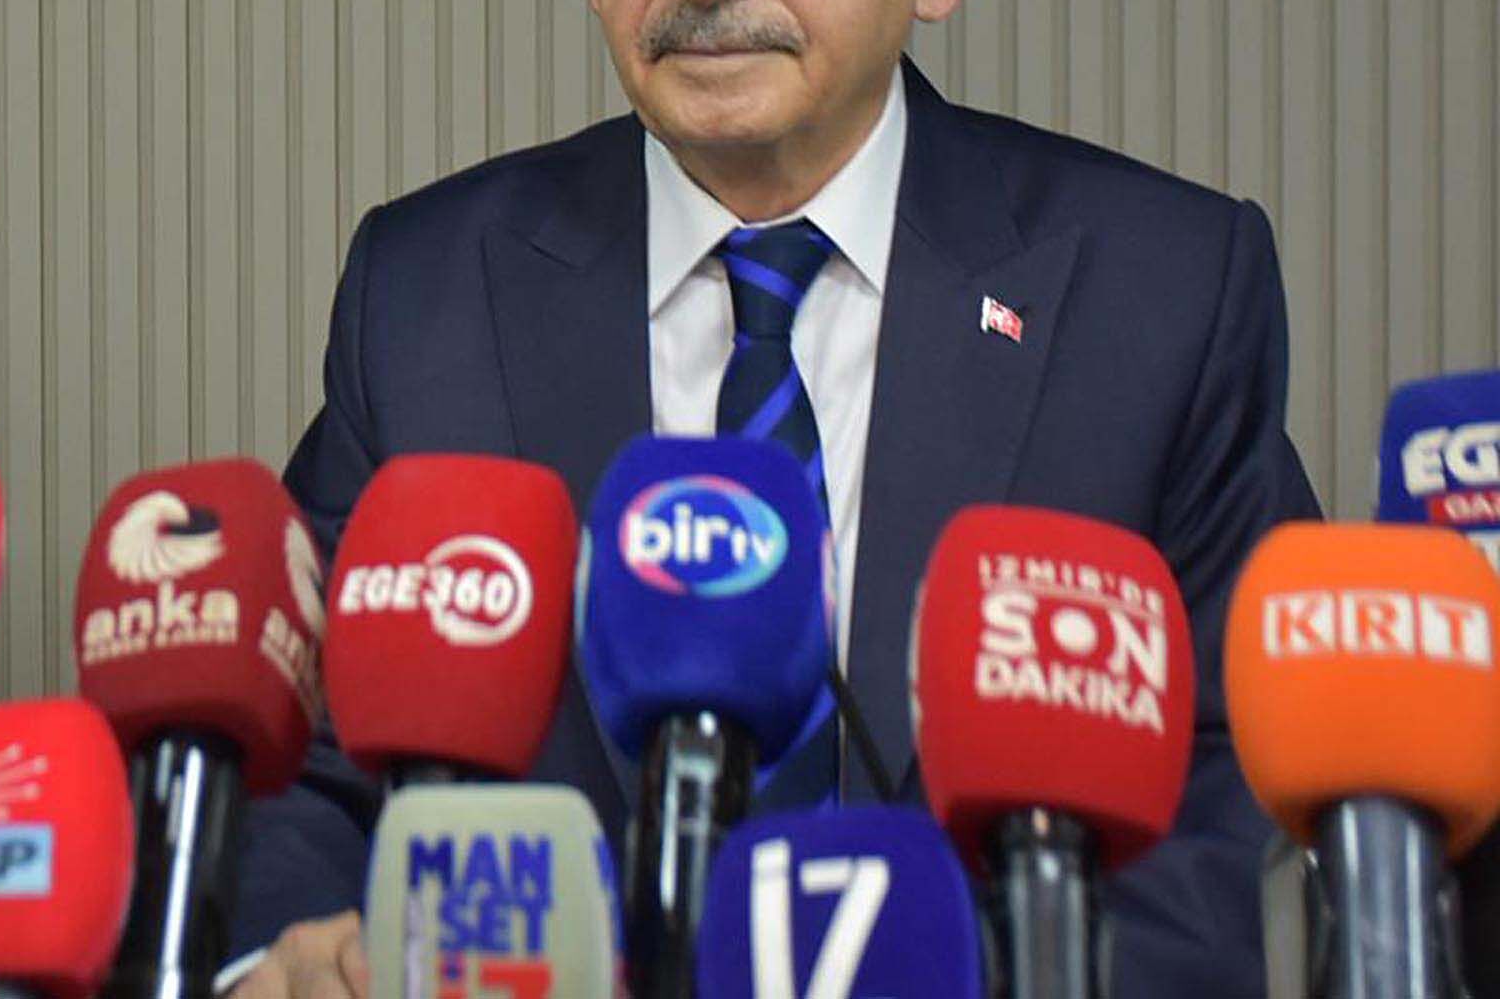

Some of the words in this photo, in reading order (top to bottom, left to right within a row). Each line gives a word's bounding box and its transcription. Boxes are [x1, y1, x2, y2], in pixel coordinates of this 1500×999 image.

[83, 577, 239, 642] anka
[981, 584, 1167, 694] SON
[1265, 590, 1493, 668] KRT
[407, 832, 554, 908] MAN
